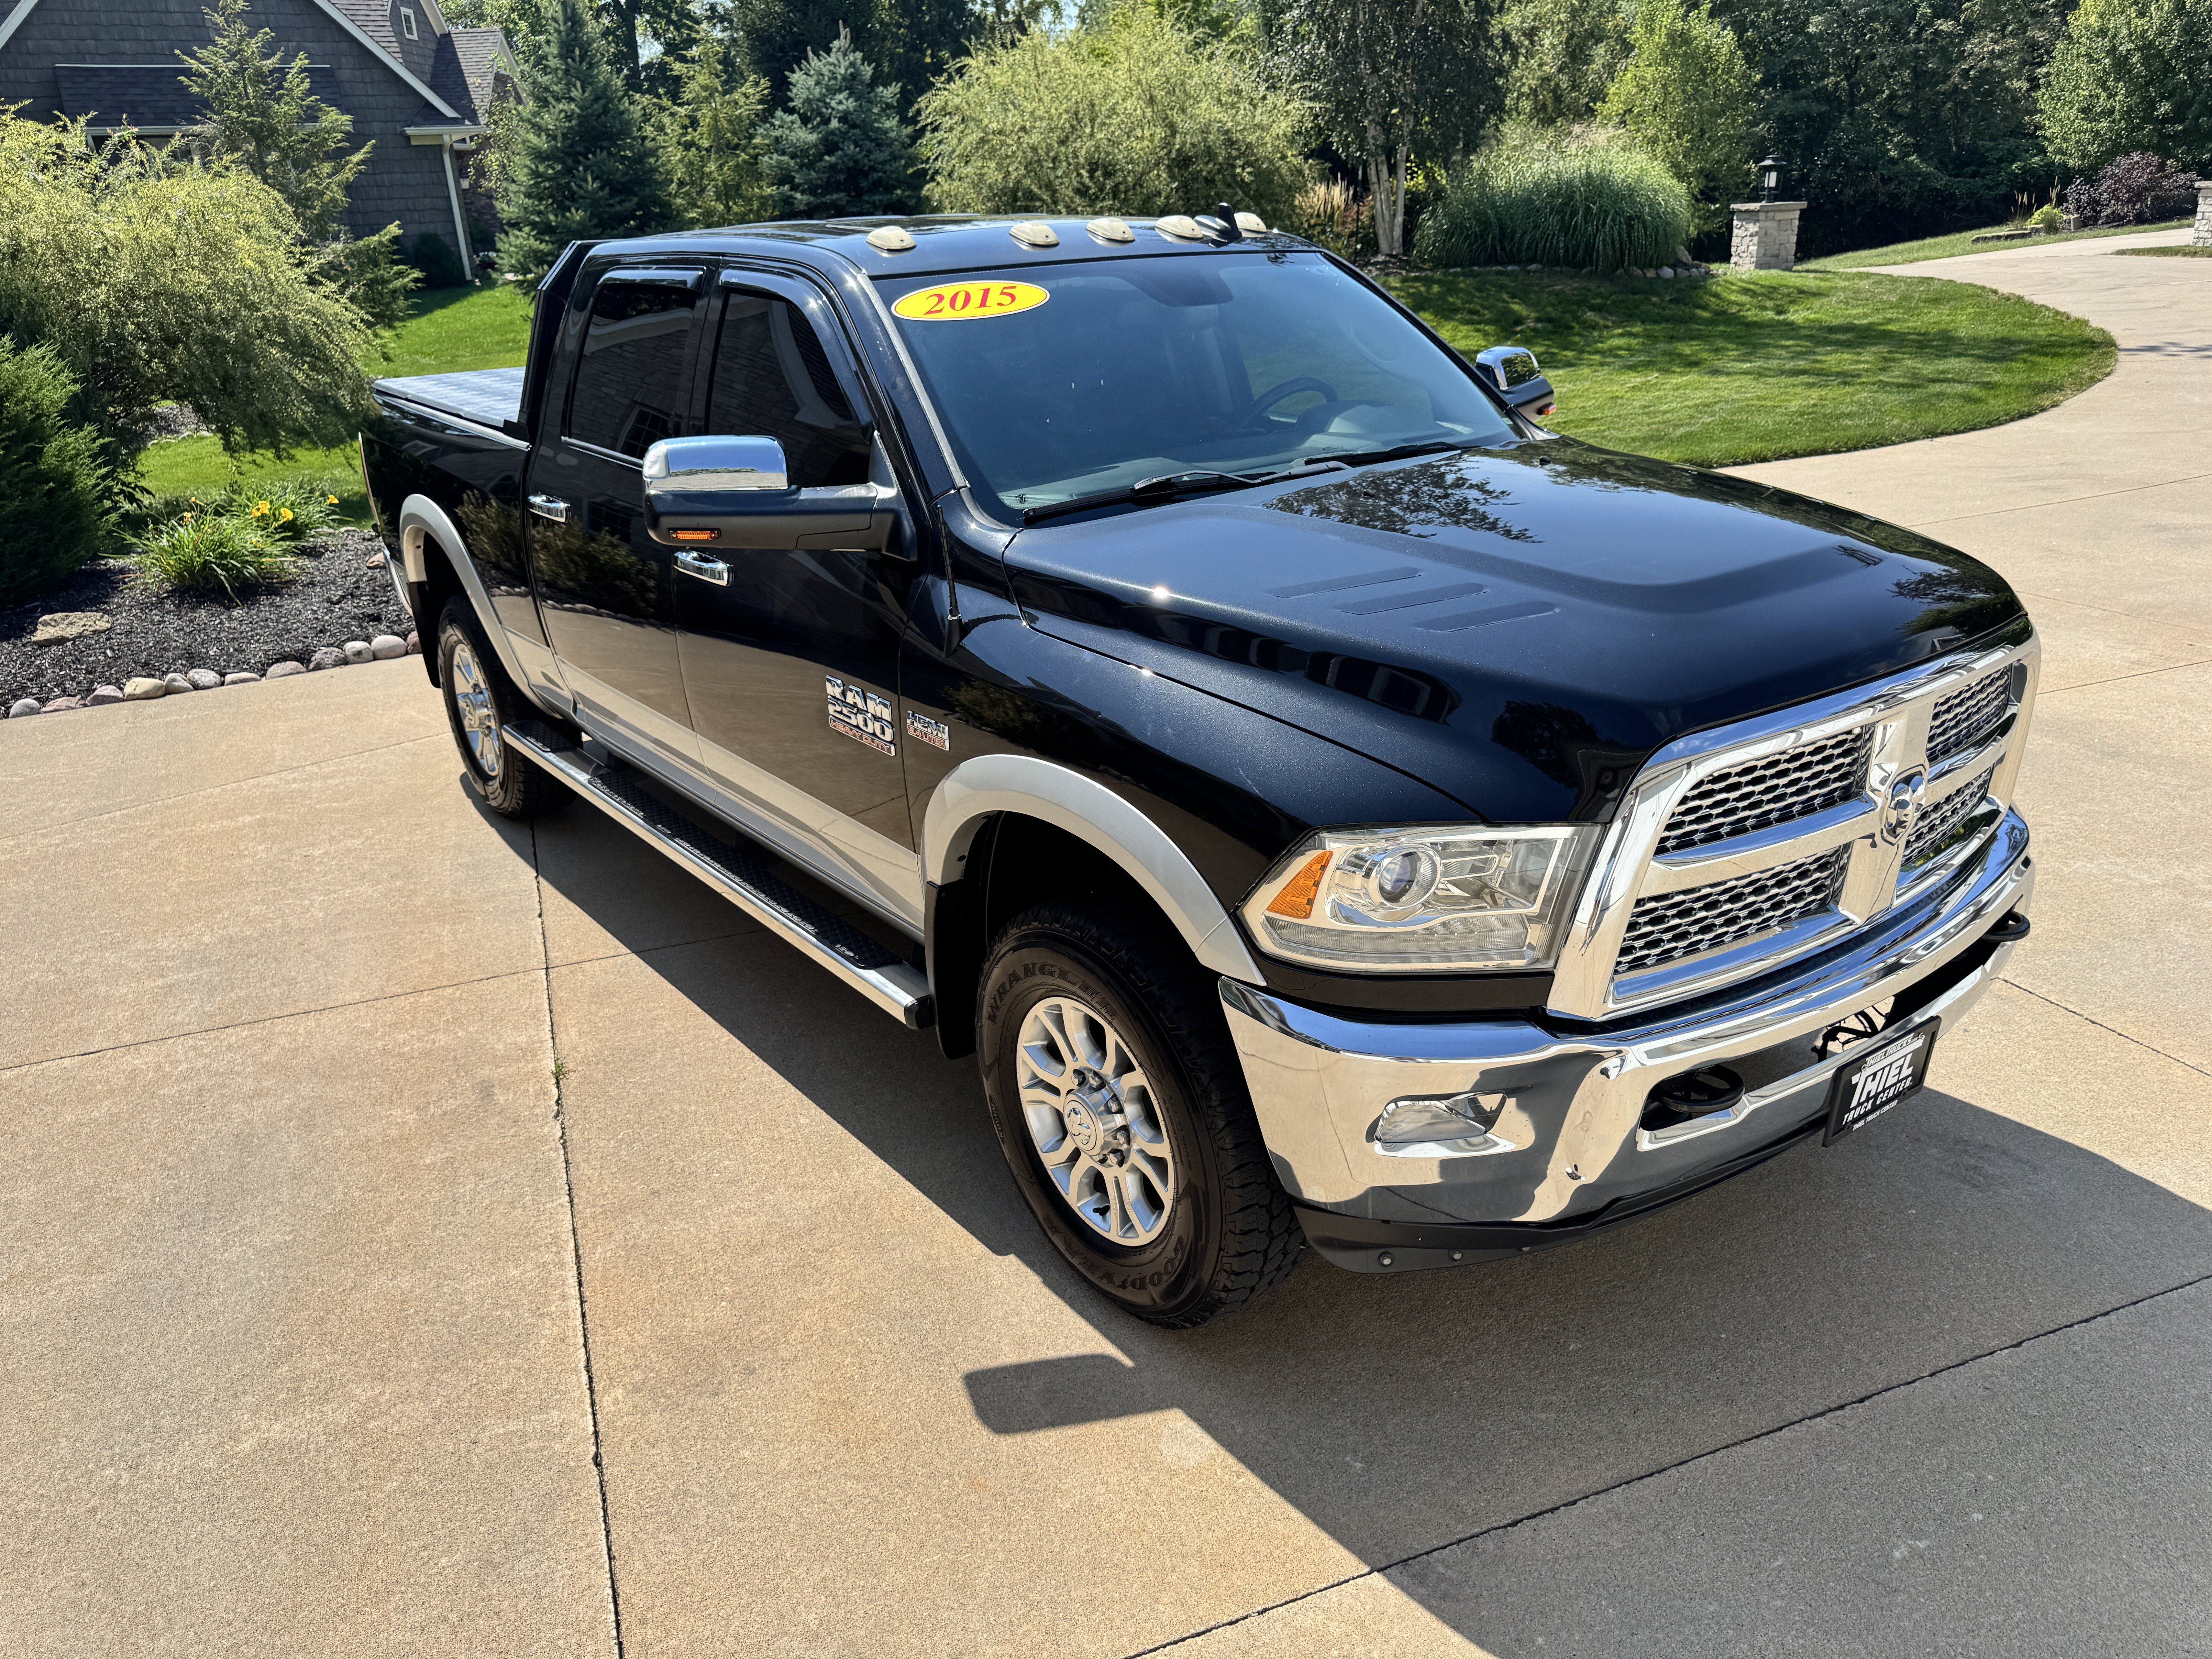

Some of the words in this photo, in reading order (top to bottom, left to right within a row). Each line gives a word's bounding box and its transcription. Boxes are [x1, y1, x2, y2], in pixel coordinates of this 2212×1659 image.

[923, 285, 1017, 316] 2015
[825, 674, 893, 722] RAM
[827, 695, 895, 742] 2500
[831, 719, 861, 740] HEAVY
[862, 733, 890, 752] DUTY
[907, 710, 949, 740] HEMI
[922, 732, 946, 748] LITER
[986, 962, 1117, 1024] WRANGLER
[1850, 1038, 1924, 1109] THIEL
[1843, 1098, 1874, 1125] TRUCK
[1876, 1076, 1912, 1105] CENTER
[1853, 1119, 1865, 1131] THIEL
[1866, 1109, 1880, 1123] TRUCK
[1881, 1099, 1898, 1114] CENTER
